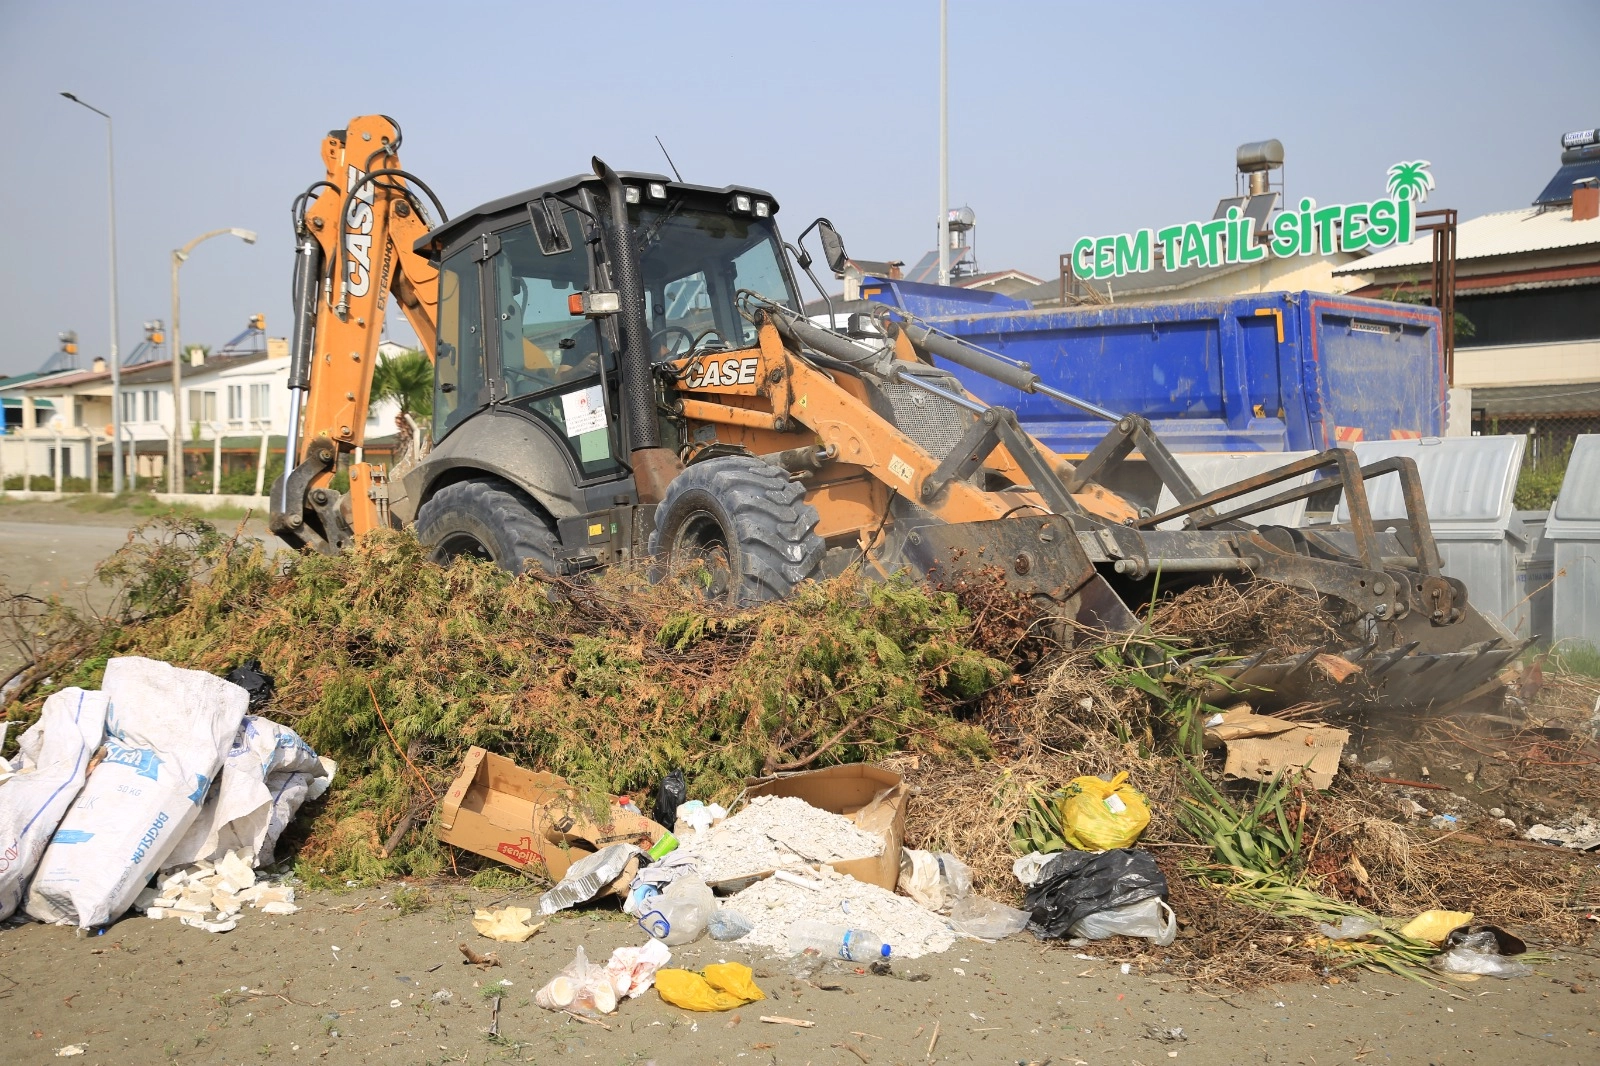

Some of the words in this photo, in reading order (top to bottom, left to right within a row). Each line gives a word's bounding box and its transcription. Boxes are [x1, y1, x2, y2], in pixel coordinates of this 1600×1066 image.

[346, 164, 375, 297] CASE
[1071, 229, 1154, 280] CEM
[1157, 206, 1269, 272] TATİL
[1271, 184, 1416, 258] SİTESİ
[685, 357, 759, 389] CASE
[117, 784, 129, 793] 50
[129, 787, 142, 797] KG
